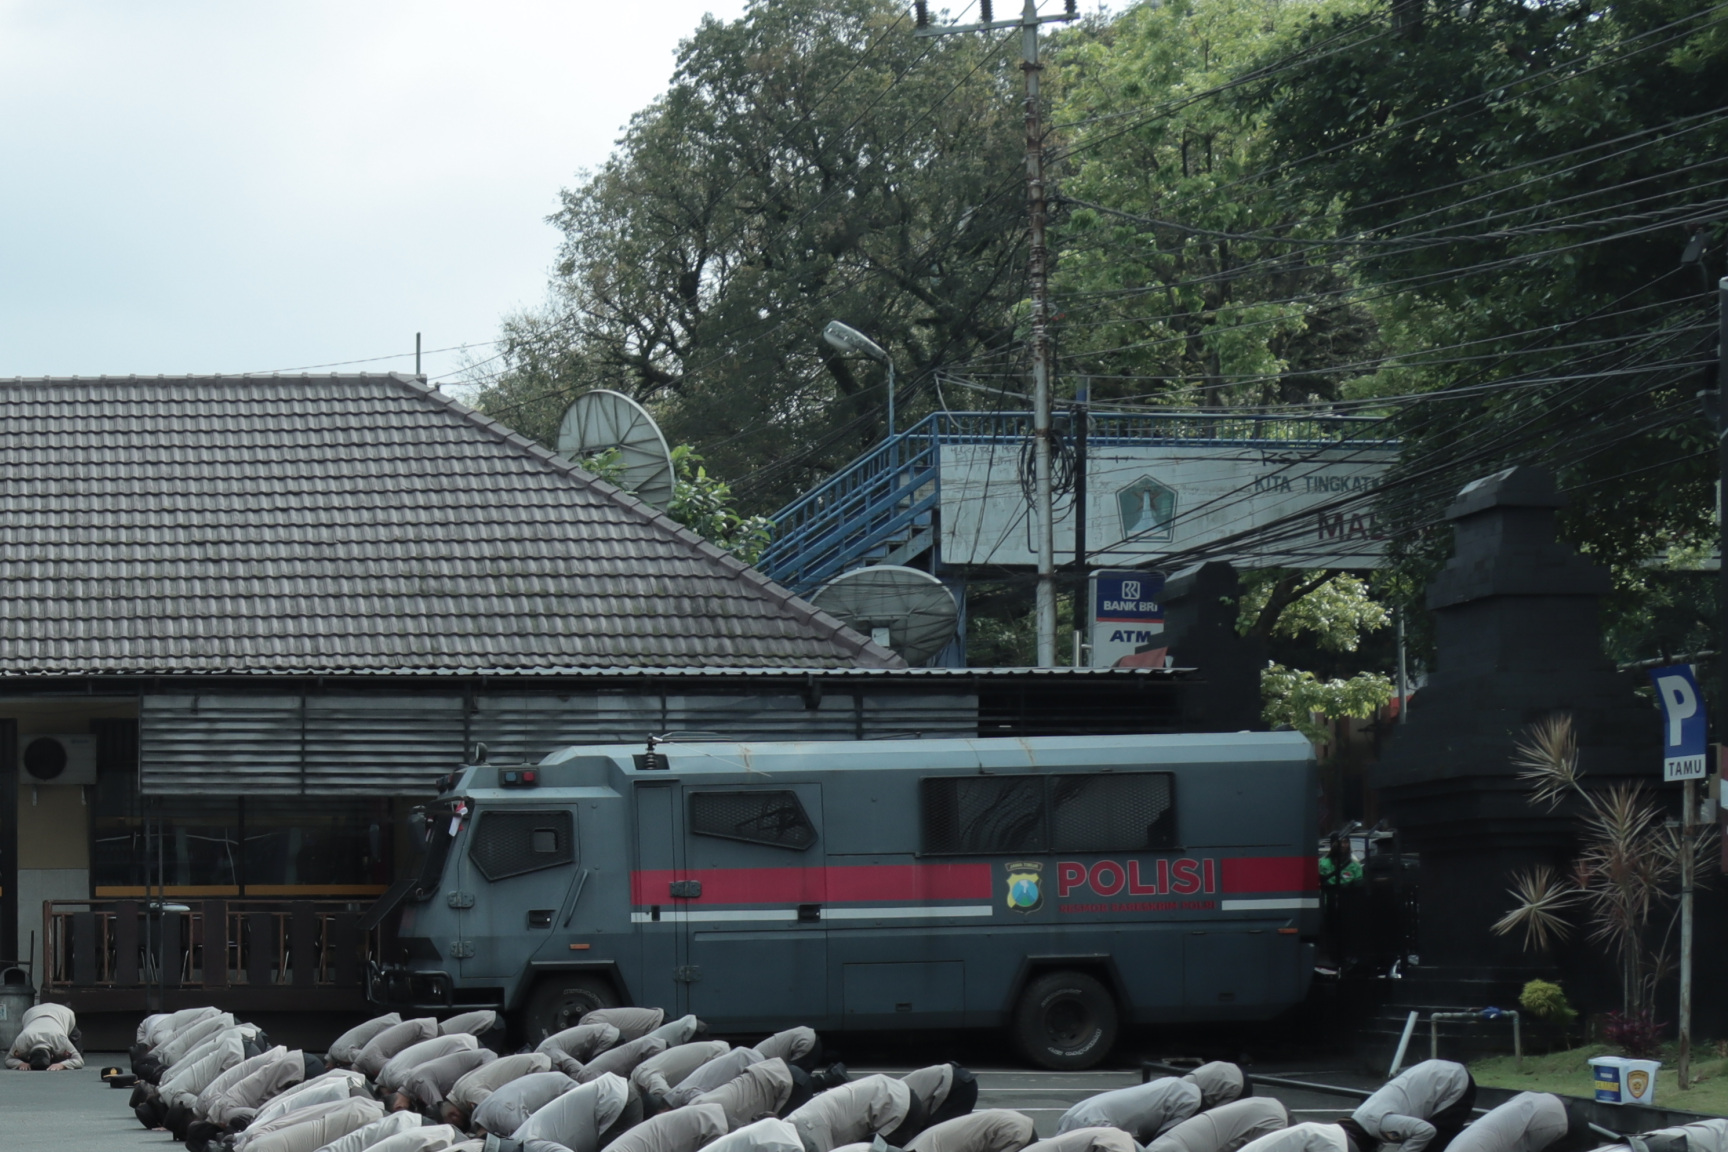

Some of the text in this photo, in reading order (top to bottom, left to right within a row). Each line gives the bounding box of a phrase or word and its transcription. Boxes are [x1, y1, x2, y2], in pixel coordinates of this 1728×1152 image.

[1255, 475, 1291, 492] KITA
[1104, 601, 1137, 611] BANK
[1110, 630, 1151, 643] ATM
[1657, 675, 1697, 746] P
[1669, 759, 1701, 777] TAMU
[1057, 858, 1216, 898] POLISI
